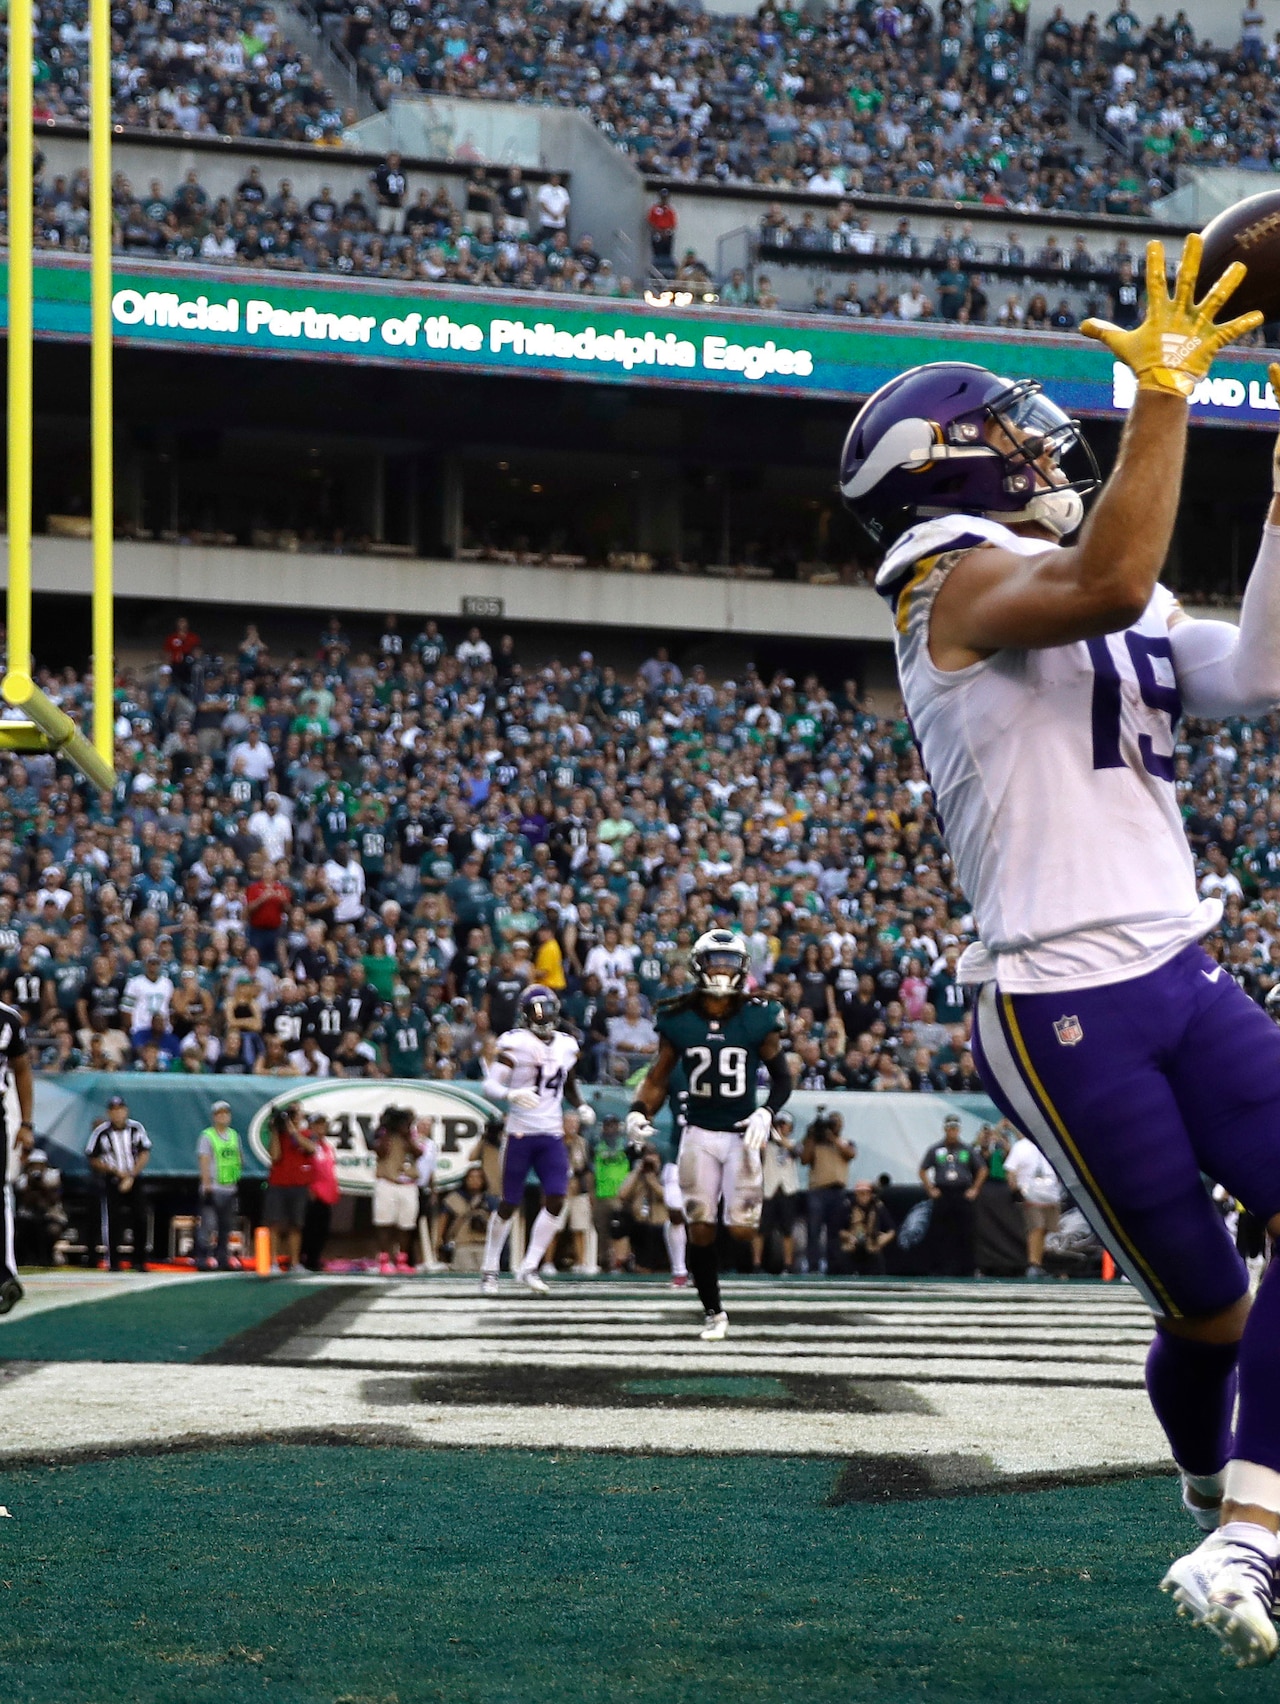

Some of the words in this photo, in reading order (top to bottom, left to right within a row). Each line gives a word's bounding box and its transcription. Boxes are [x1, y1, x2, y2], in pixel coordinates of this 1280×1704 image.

[112, 289, 240, 333] Official
[246, 300, 376, 343] Partner
[381, 312, 422, 347] of
[424, 315, 484, 352] the
[490, 319, 696, 370] Philadelphia
[703, 336, 813, 380] Eagles
[534, 1064, 568, 1098] 14
[685, 1046, 748, 1098] 29
